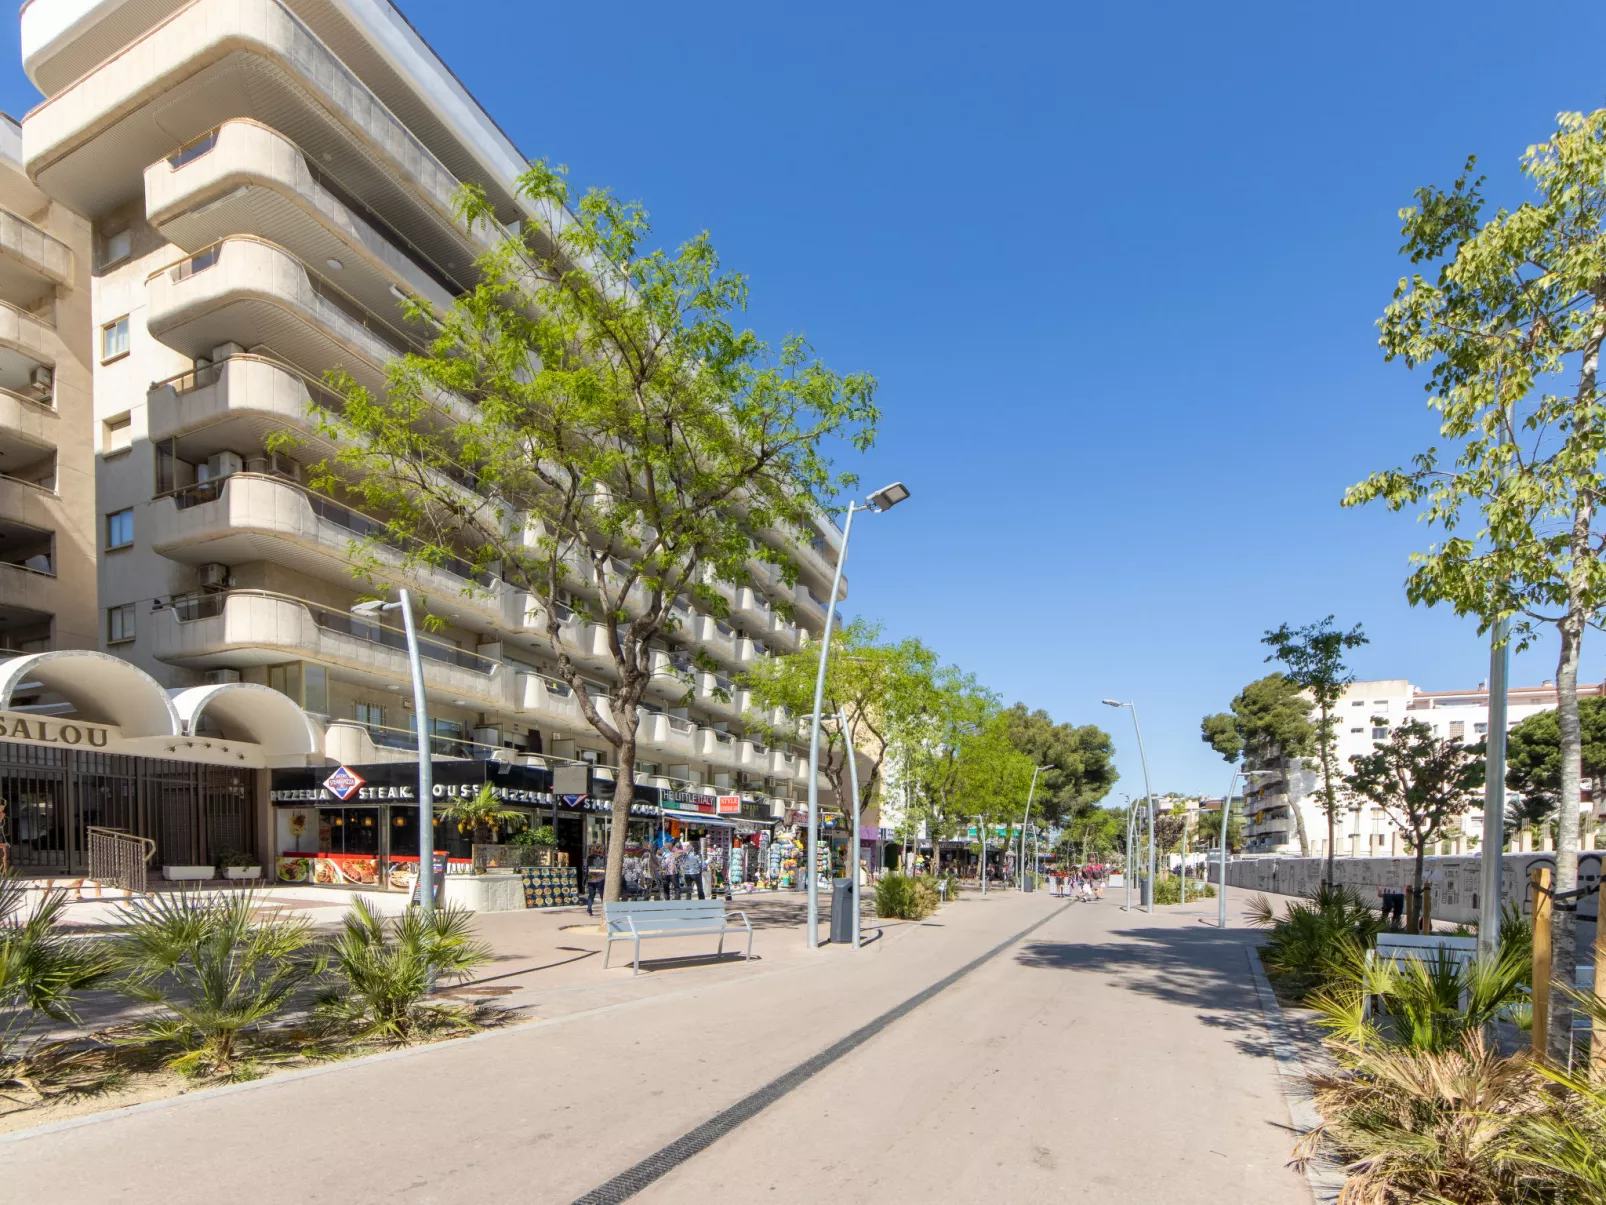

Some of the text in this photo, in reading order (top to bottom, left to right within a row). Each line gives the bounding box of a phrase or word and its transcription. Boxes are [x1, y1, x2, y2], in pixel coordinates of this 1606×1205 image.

[270, 784, 481, 801] PIZZERIA STEAK OUSE
[675, 791, 697, 804] LITTLE
[697, 796, 714, 806] ITALY
[584, 798, 613, 811] STEA
